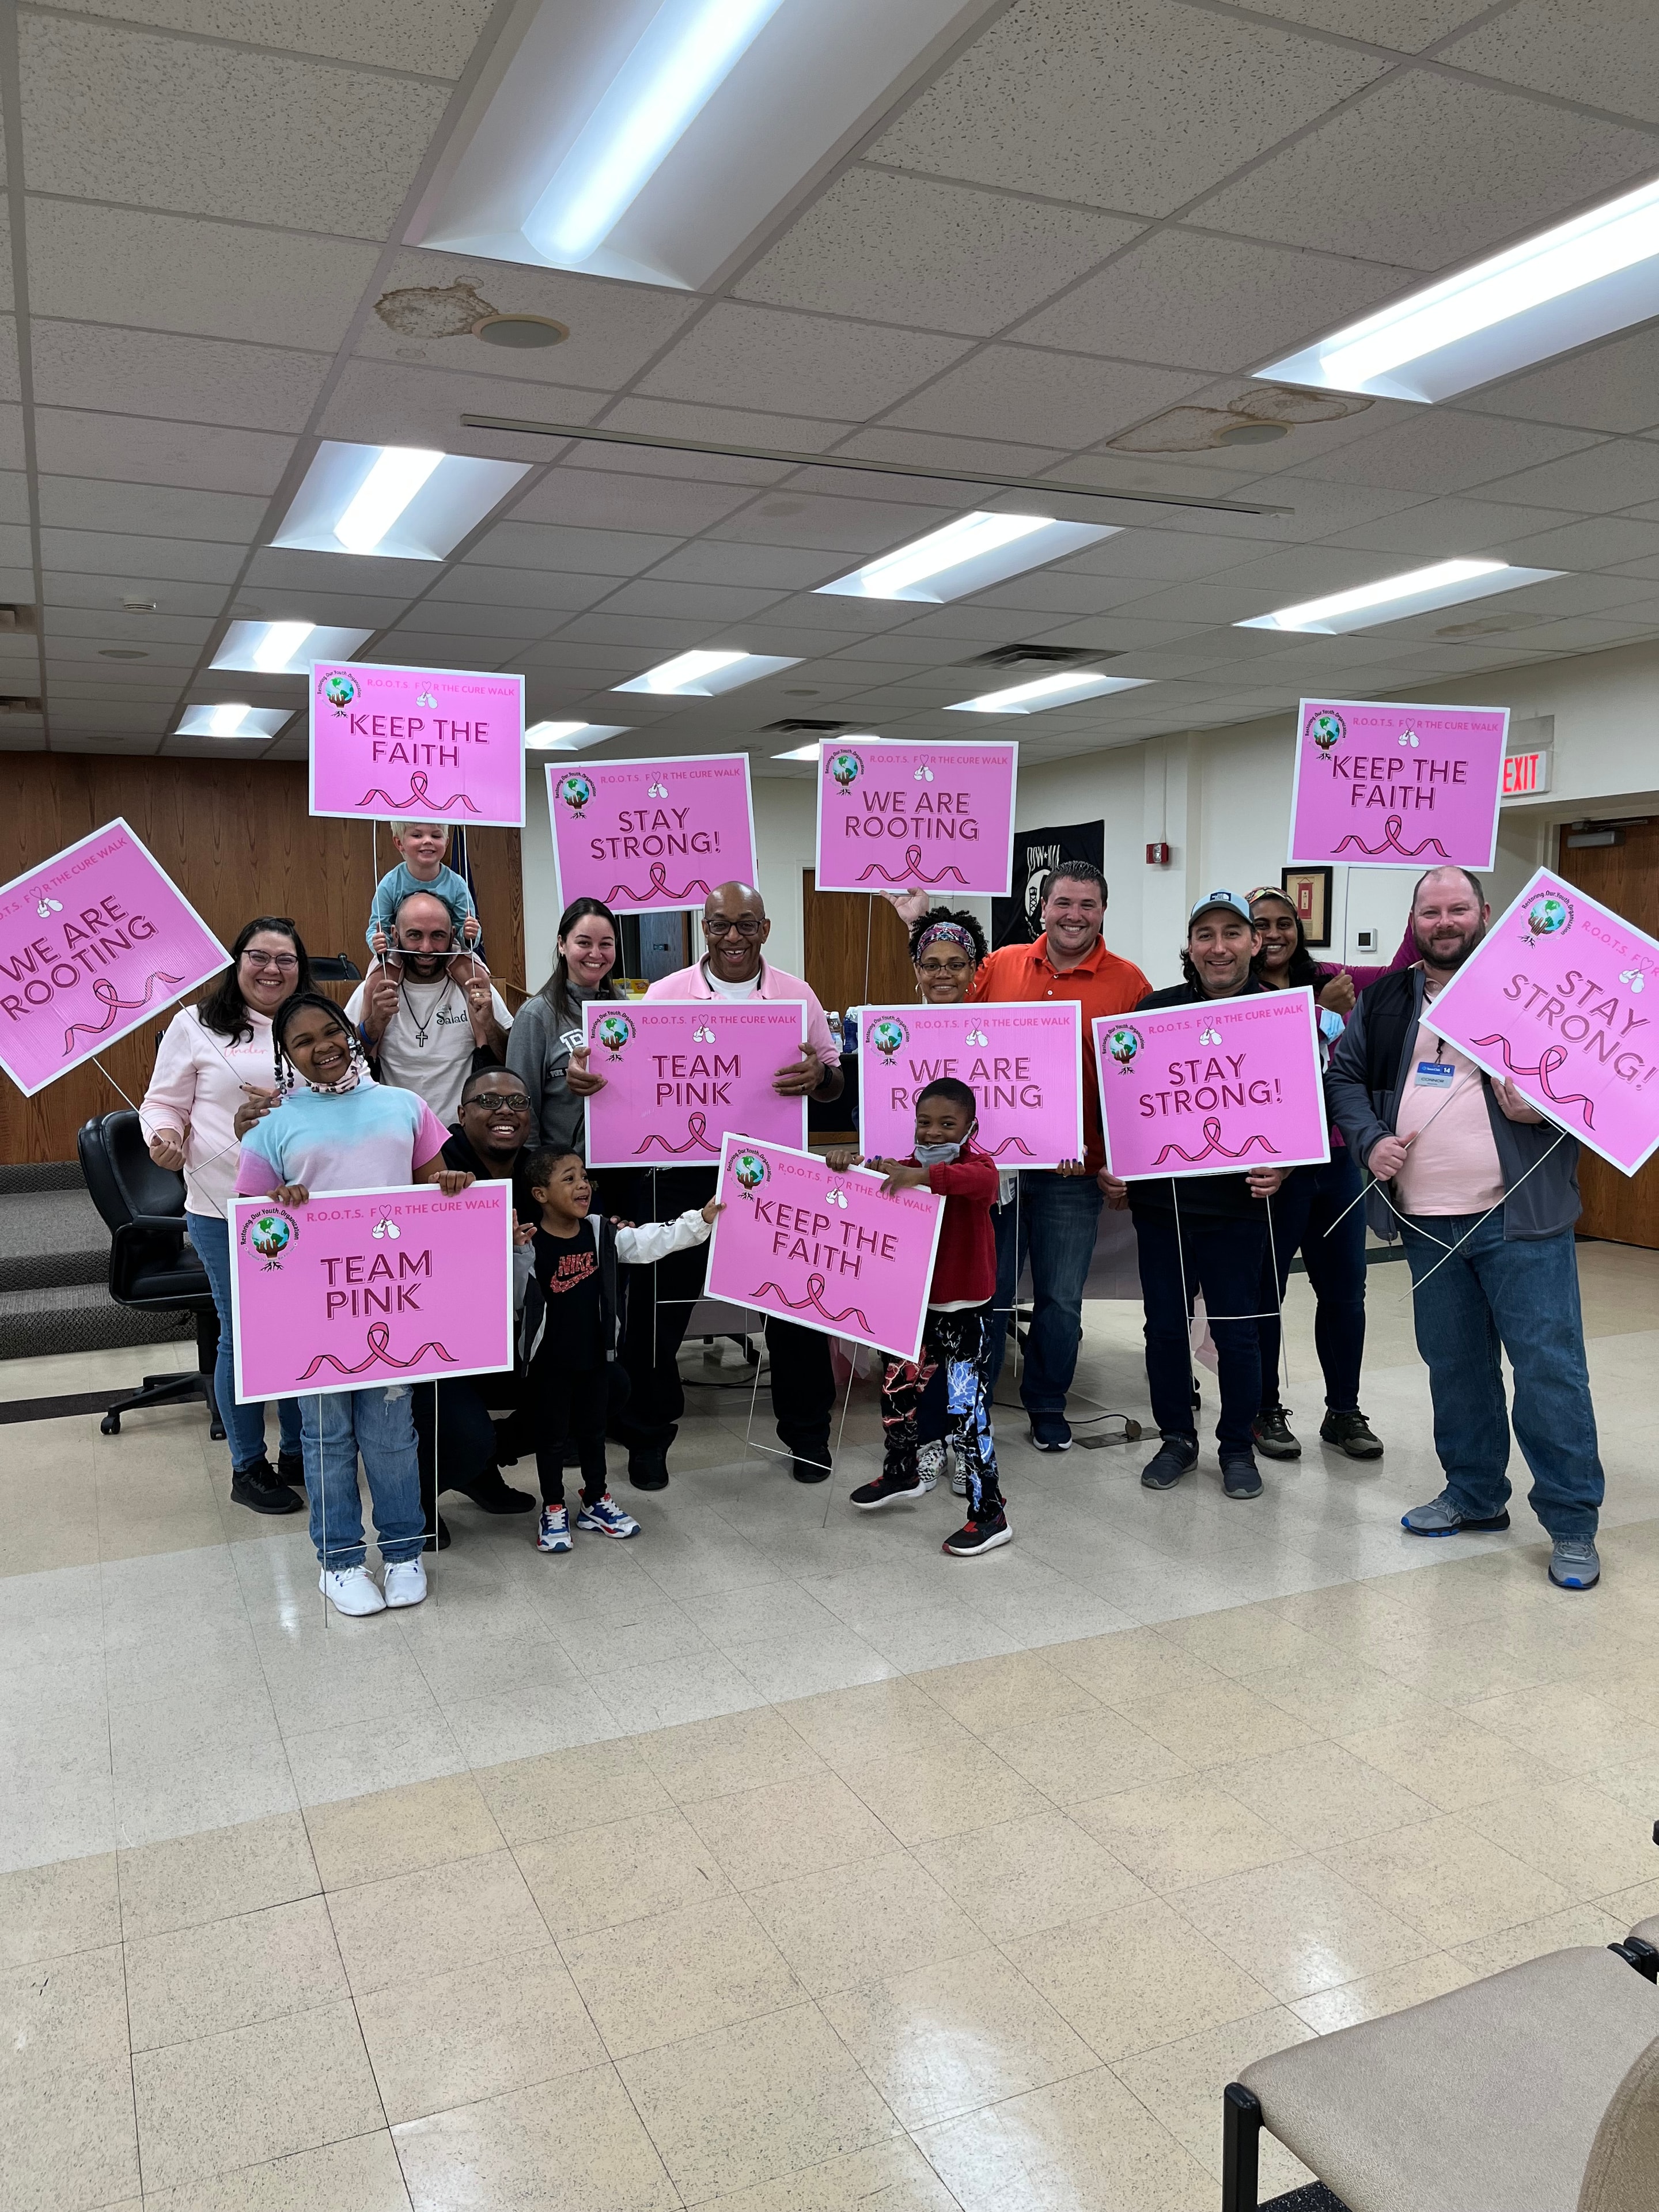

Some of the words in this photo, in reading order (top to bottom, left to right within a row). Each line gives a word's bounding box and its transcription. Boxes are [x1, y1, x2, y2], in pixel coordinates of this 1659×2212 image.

[368, 679, 410, 689] R.O.O.T.S.
[462, 685, 485, 694] CURE
[488, 687, 515, 696] WALK
[350, 713, 425, 738] KEEP
[433, 719, 489, 744] THE
[1353, 718, 1393, 727] R.O.O.T.S.
[1444, 722, 1468, 730] CURE
[1471, 723, 1499, 732] WALK
[373, 741, 460, 767] FAITH
[600, 774, 641, 783] R.O.O.T.S.
[690, 770, 712, 778] CURE
[714, 768, 740, 777] WALK
[1332, 755, 1405, 781] KEEP
[1412, 758, 1468, 784] THE
[1502, 755, 1539, 793] EXIT
[863, 791, 907, 813] WE
[915, 792, 971, 815] ARE
[1351, 784, 1435, 810] FAITH
[619, 808, 690, 832] STAY
[846, 816, 979, 840] ROOTING
[590, 831, 721, 860] STRONG!
[50, 868, 72, 887] THE
[71, 855, 99, 875] CURE
[97, 838, 127, 859] WALK
[0, 937, 61, 983] WE
[62, 895, 128, 949] ARE
[1581, 921, 1628, 957] R.O.O.T.S.
[0, 915, 159, 1021] ROOTING
[436, 1009, 468, 1025] Salad
[1556, 970, 1650, 1037] STAY
[642, 1016, 687, 1024] R.O.O.T.S.
[767, 1016, 797, 1024] WALK
[915, 1021, 959, 1029] R.O.O.T.S.
[1041, 1017, 1070, 1025] WALK
[1148, 1023, 1192, 1035] R.O.O.T.S.
[1224, 1014, 1243, 1023] THE
[1245, 1010, 1271, 1020] CURE
[1272, 1005, 1303, 1016] WALK
[1503, 974, 1657, 1091] STRONG!
[652, 1055, 741, 1079] TEAM
[968, 1057, 1031, 1081] ARE
[1168, 1054, 1247, 1086] STAY
[656, 1082, 733, 1107] PINK
[1139, 1079, 1283, 1118] STRONG!
[778, 1163, 821, 1181] R.O.O.T.S.
[855, 1183, 873, 1196] THE
[903, 1198, 933, 1213] WALK
[306, 1210, 364, 1222] R.O.O.T.S.
[405, 1205, 429, 1214] THE
[431, 1202, 462, 1213] CURE
[465, 1199, 499, 1209] WALK
[754, 1198, 831, 1237] KEEP
[840, 1220, 898, 1261] THE
[320, 1249, 432, 1287] TEAM
[558, 1251, 594, 1277] NIKE
[772, 1231, 862, 1279] FAITH
[326, 1283, 424, 1320] PINK
